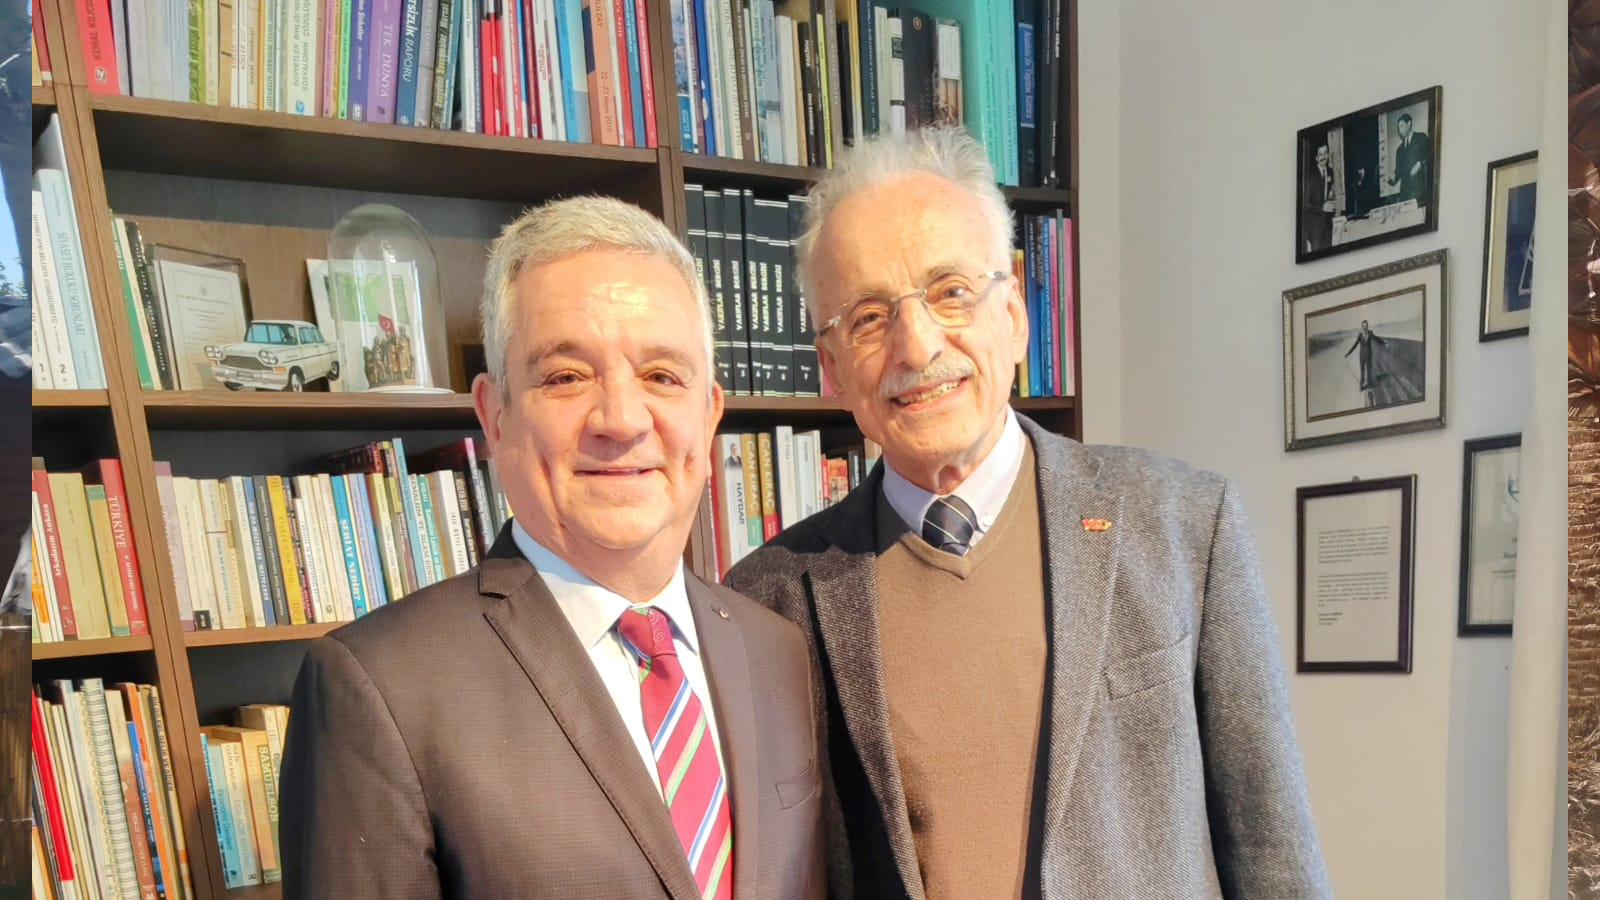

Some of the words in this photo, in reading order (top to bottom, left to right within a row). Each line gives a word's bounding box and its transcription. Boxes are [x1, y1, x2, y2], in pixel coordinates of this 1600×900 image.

[383, 24, 394, 46] TEK
[380, 54, 393, 97] DÜNYA
[403, 38, 414, 82] RAPORU
[605, 115, 613, 133] 2010
[746, 441, 756, 470] CAN
[762, 439, 772, 468] CAN
[43, 503, 54, 533] Ankara
[109, 496, 126, 548] TÜRKİYE
[49, 535, 62, 577] Arkadaşım
[259, 747, 277, 821] SAMUELSON
